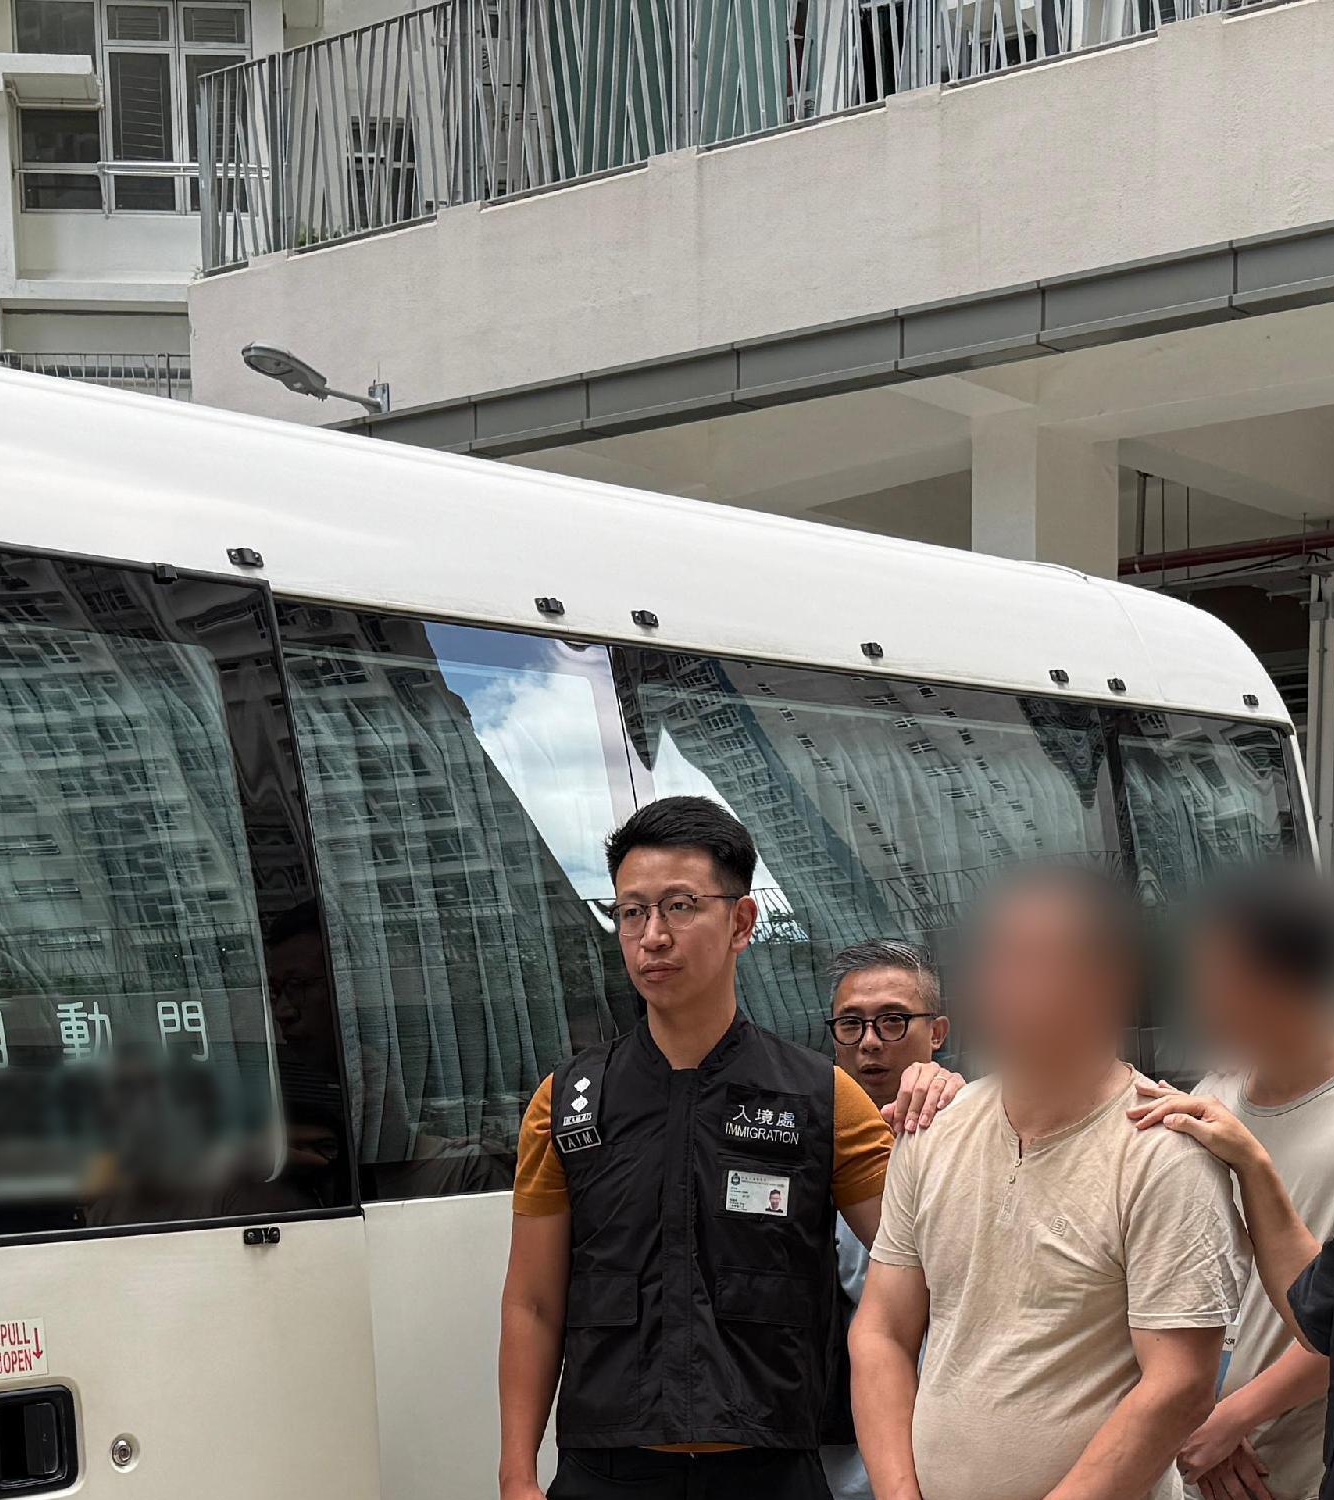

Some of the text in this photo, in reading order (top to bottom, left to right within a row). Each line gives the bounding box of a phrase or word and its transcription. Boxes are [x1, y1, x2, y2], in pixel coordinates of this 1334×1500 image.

[732, 1104, 796, 1129] 入境處
[567, 1131, 594, 1149] AIM
[725, 1121, 800, 1146] IMMIGRATION
